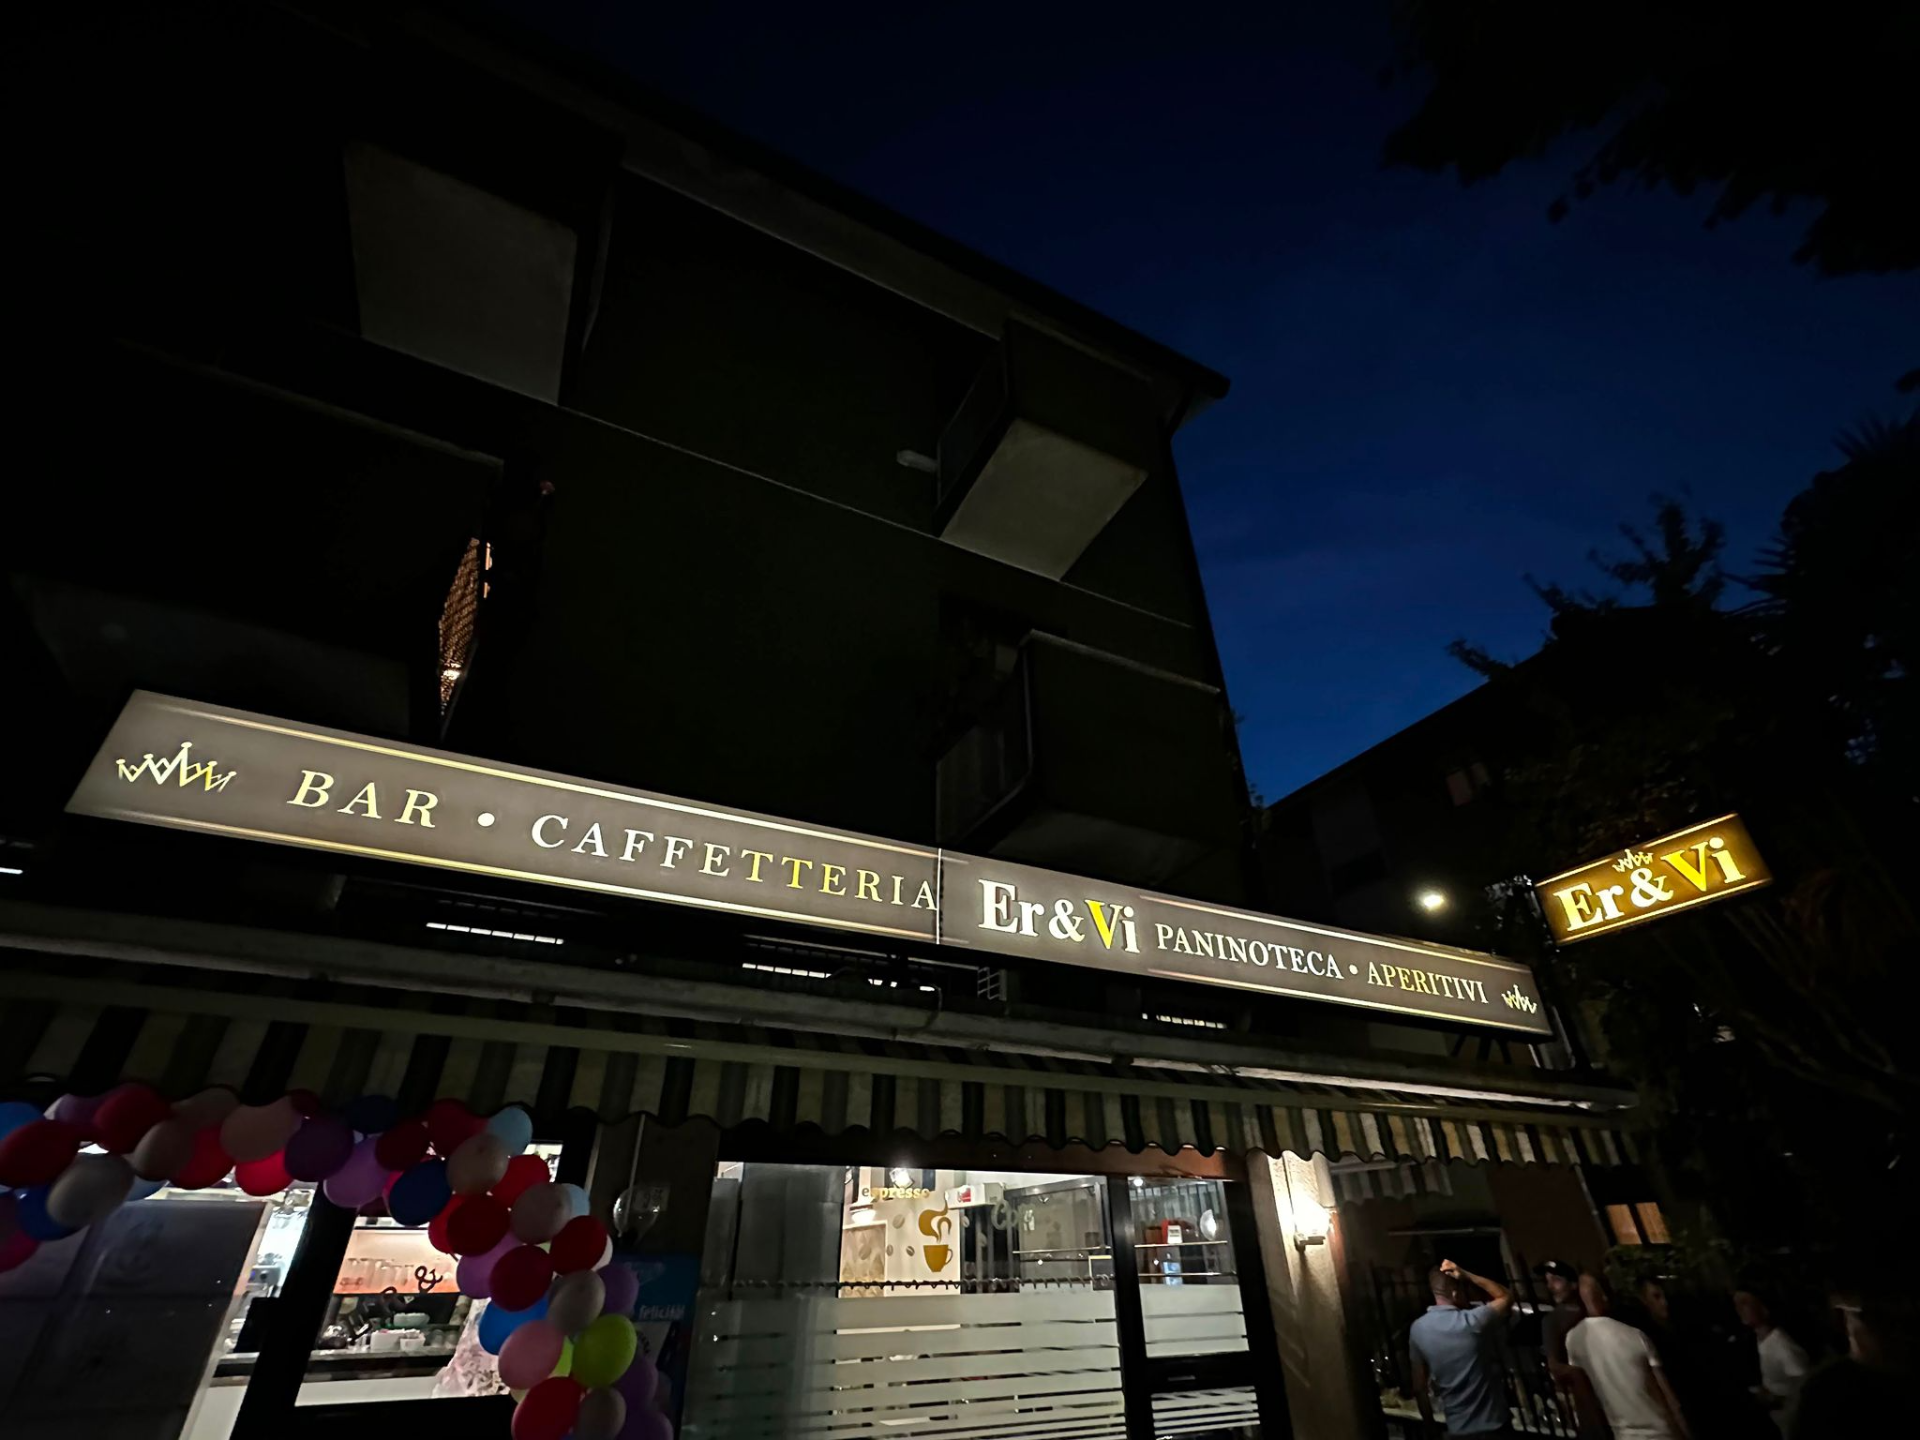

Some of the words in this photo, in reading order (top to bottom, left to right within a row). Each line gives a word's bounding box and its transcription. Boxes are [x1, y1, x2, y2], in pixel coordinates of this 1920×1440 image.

[286, 769, 439, 828] BAR
[531, 814, 938, 911] CAFFETTERIA
[1552, 836, 1747, 932] Er&Vi
[977, 878, 1141, 954] Er&Vi
[1154, 923, 1344, 980] PANINOTECA
[1366, 961, 1489, 1004] APERITIVI
